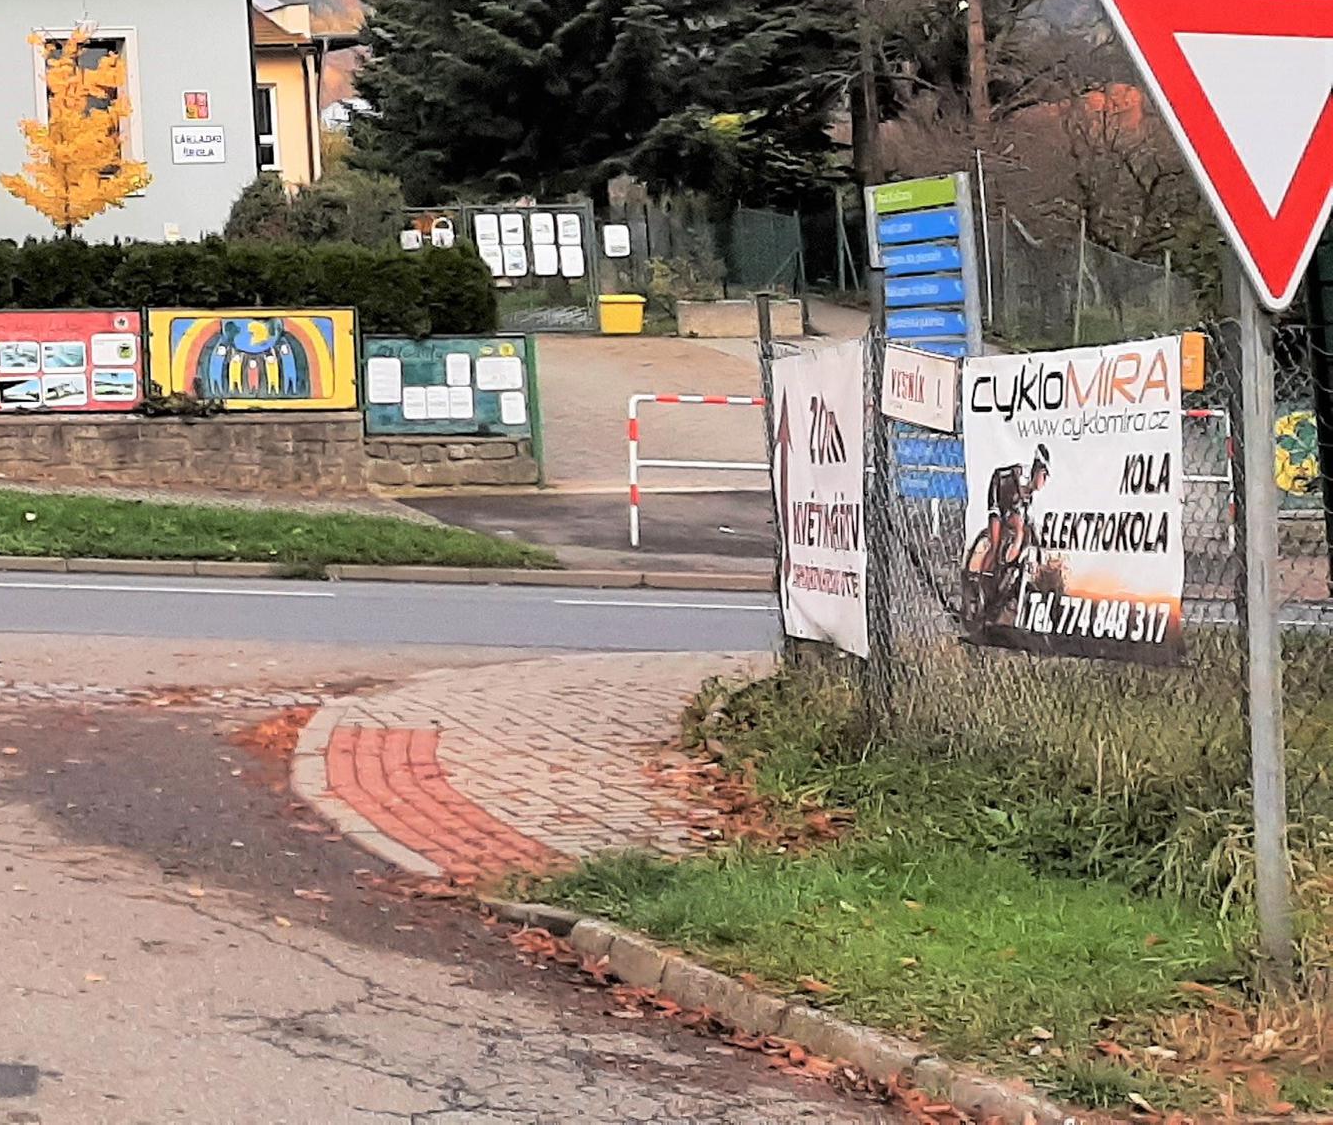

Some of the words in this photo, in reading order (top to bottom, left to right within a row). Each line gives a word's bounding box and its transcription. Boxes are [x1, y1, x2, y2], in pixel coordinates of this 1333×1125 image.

[1017, 409, 1170, 440] www.cyklomira.cz
[1119, 452, 1171, 495] KOLA
[1040, 511, 1169, 553] ELEKTROKOLA
[1056, 595, 1093, 637] 774
[1092, 599, 1130, 641] 848
[1131, 602, 1171, 644] 317
